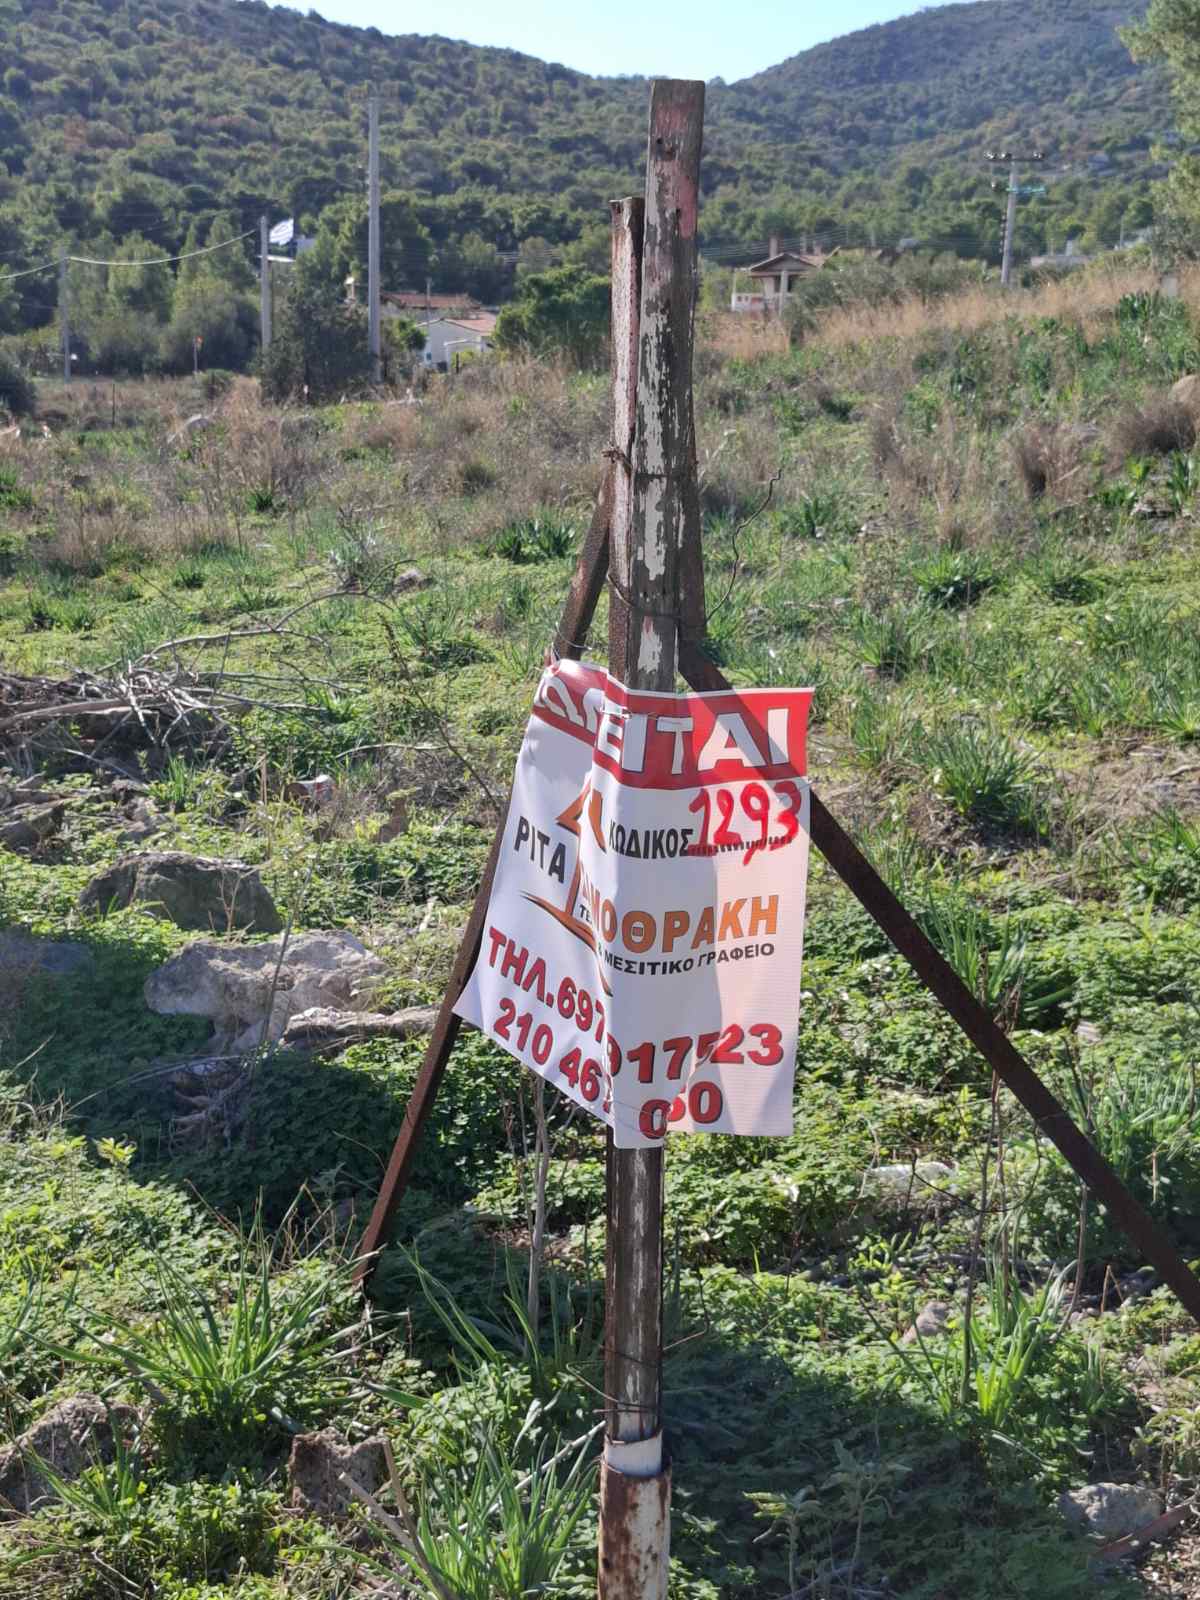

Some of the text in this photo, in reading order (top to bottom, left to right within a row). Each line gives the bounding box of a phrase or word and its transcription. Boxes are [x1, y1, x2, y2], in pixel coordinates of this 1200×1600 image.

[514, 816, 567, 884] ΡΙΤΑ
[609, 819, 693, 860] ΚΩΔΙΚΟΣ
[688, 781, 802, 866] 1293
[604, 942, 775, 976] ΜΕΣΙΤΙΚΟ ΓΡΑΦΕΙΟ
[493, 997, 553, 1066] 210
